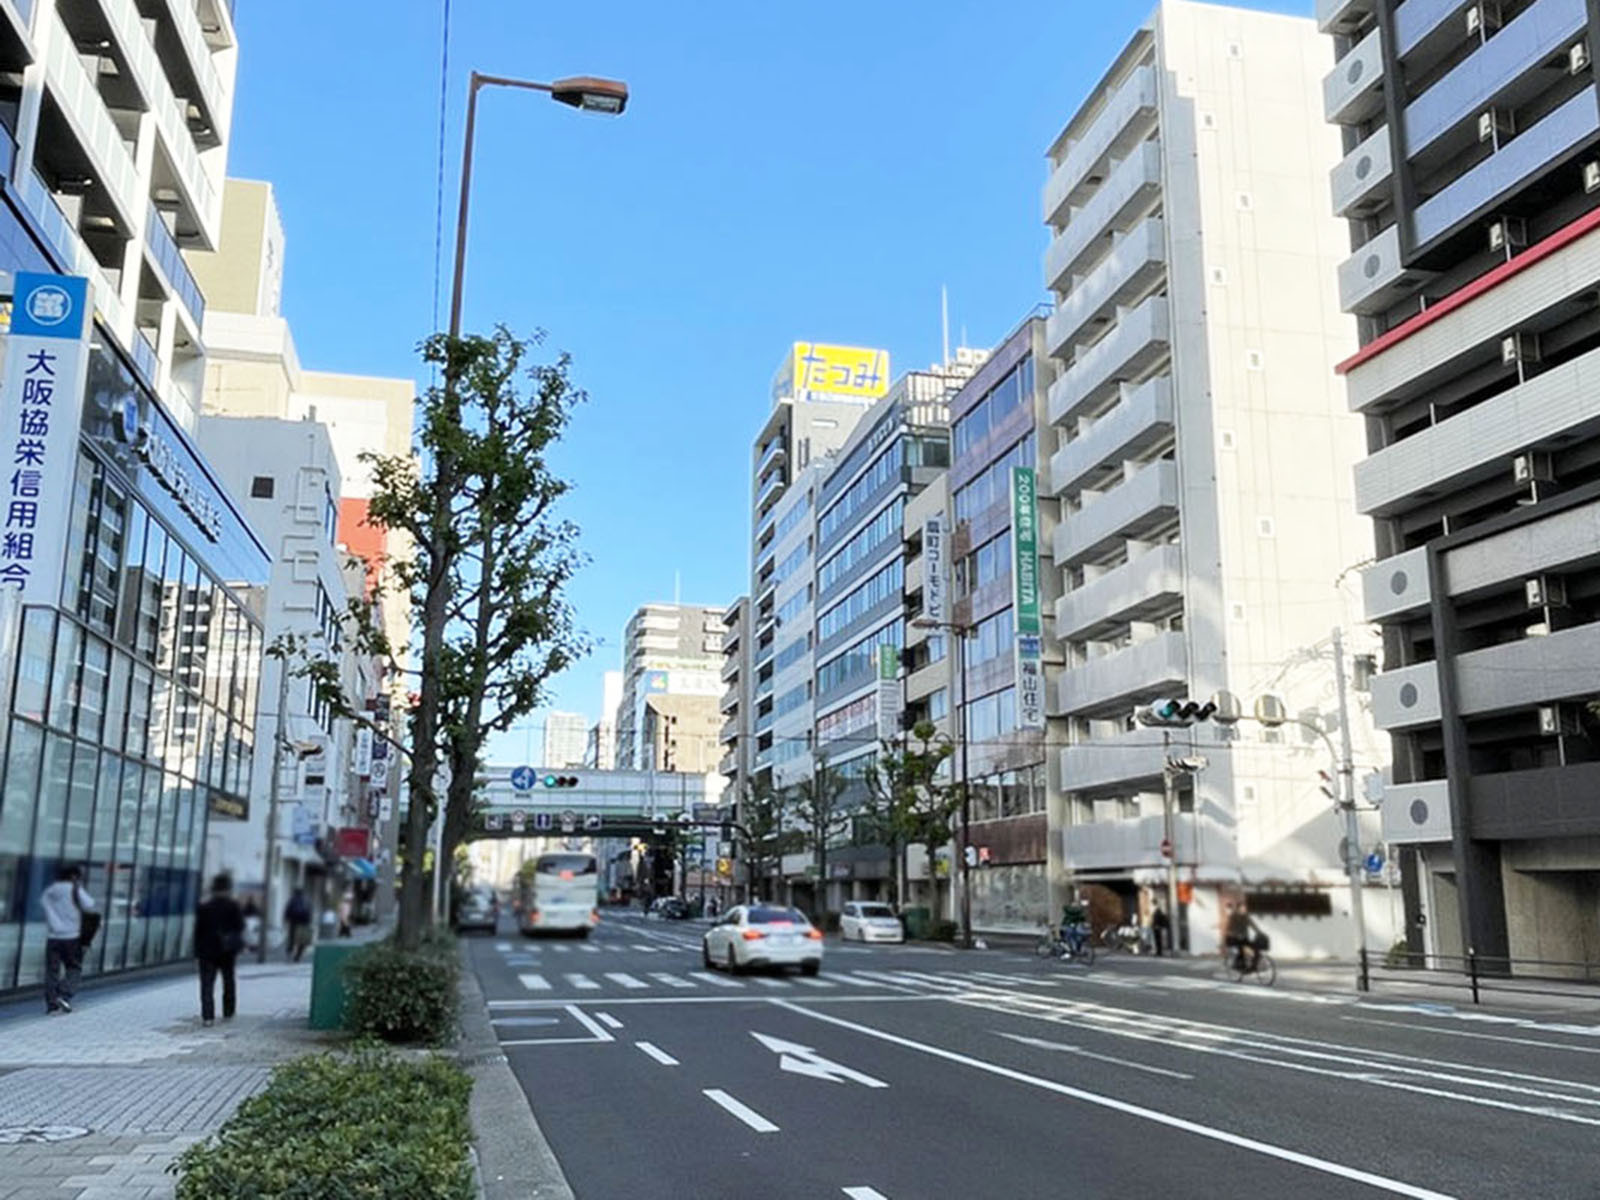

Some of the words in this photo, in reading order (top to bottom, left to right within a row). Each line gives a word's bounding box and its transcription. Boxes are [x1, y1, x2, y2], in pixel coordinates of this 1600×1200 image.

[801, 346, 881, 390] たつみ
[0, 349, 57, 592] 大阪協栄信用組合
